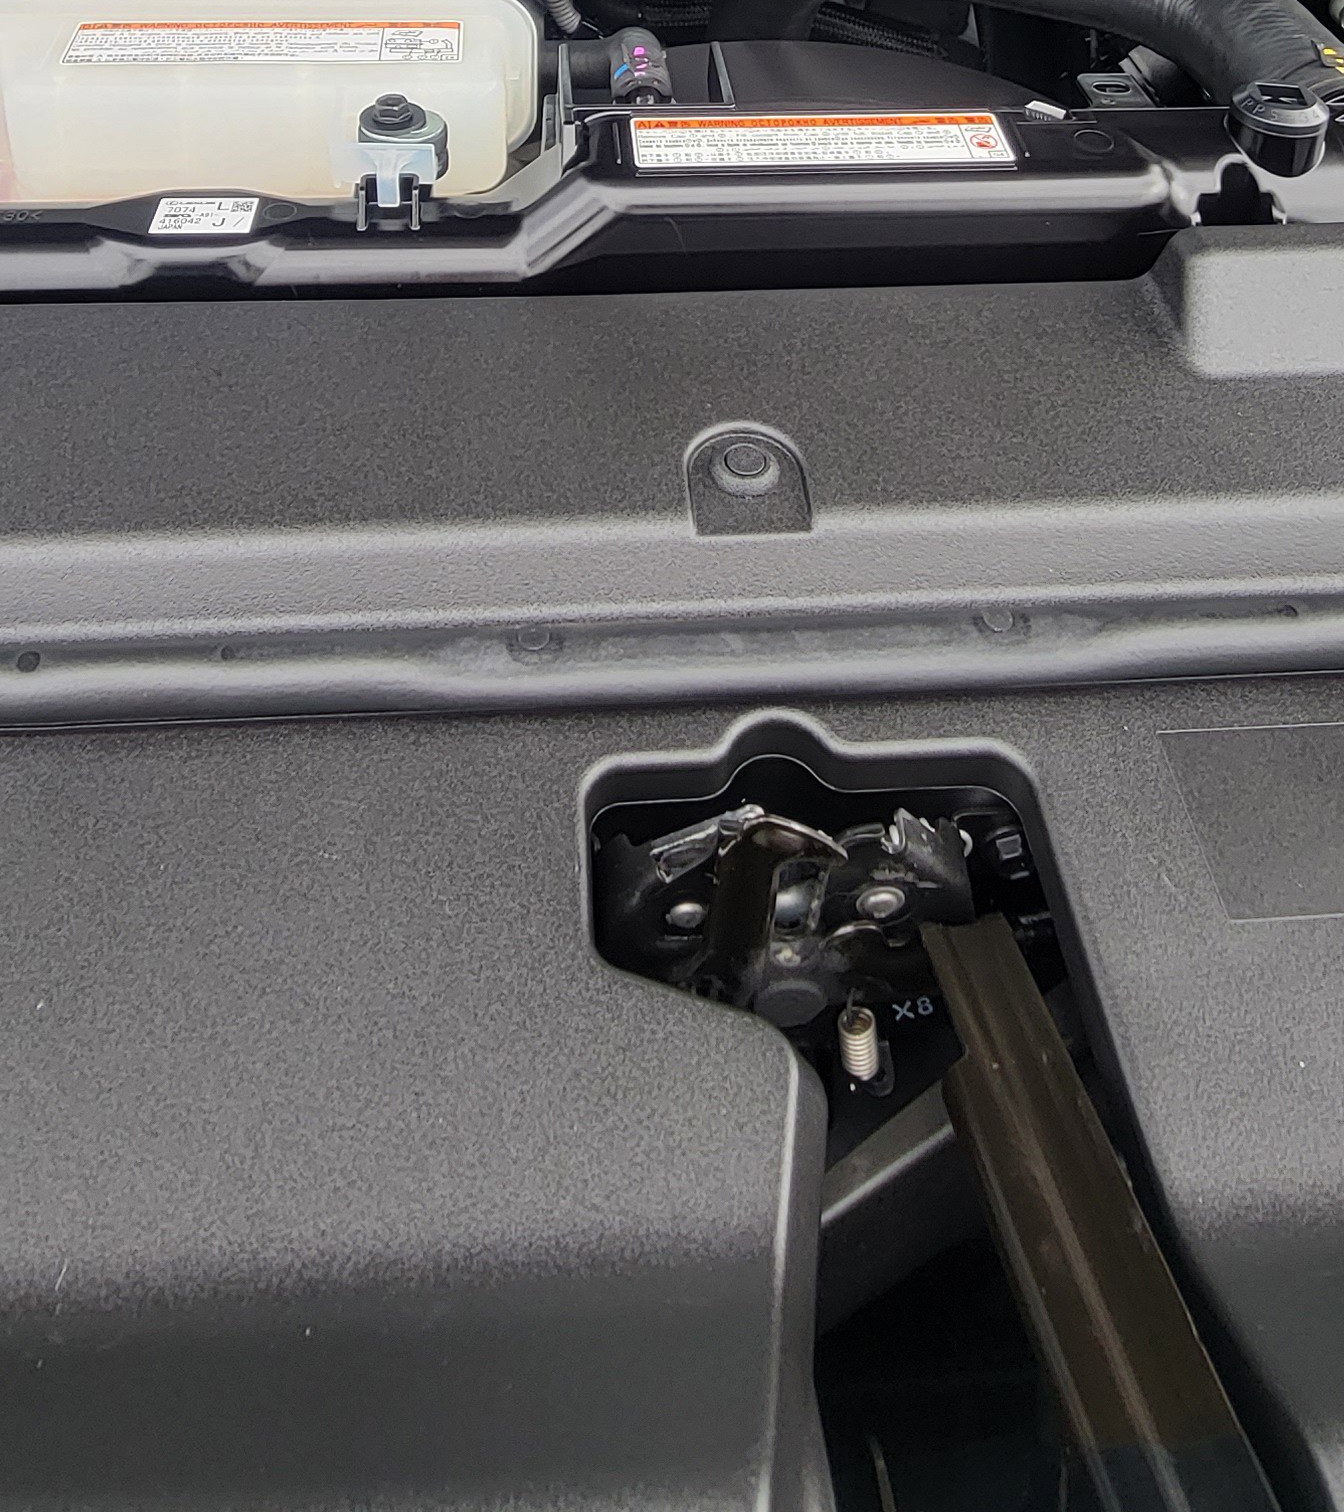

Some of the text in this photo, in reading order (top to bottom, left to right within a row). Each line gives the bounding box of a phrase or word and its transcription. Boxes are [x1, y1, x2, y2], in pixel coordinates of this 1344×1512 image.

[698, 119, 746, 128] WARNING
[216, 201, 230, 211] L
[212, 217, 226, 227] J
[892, 995, 934, 1021] X8
